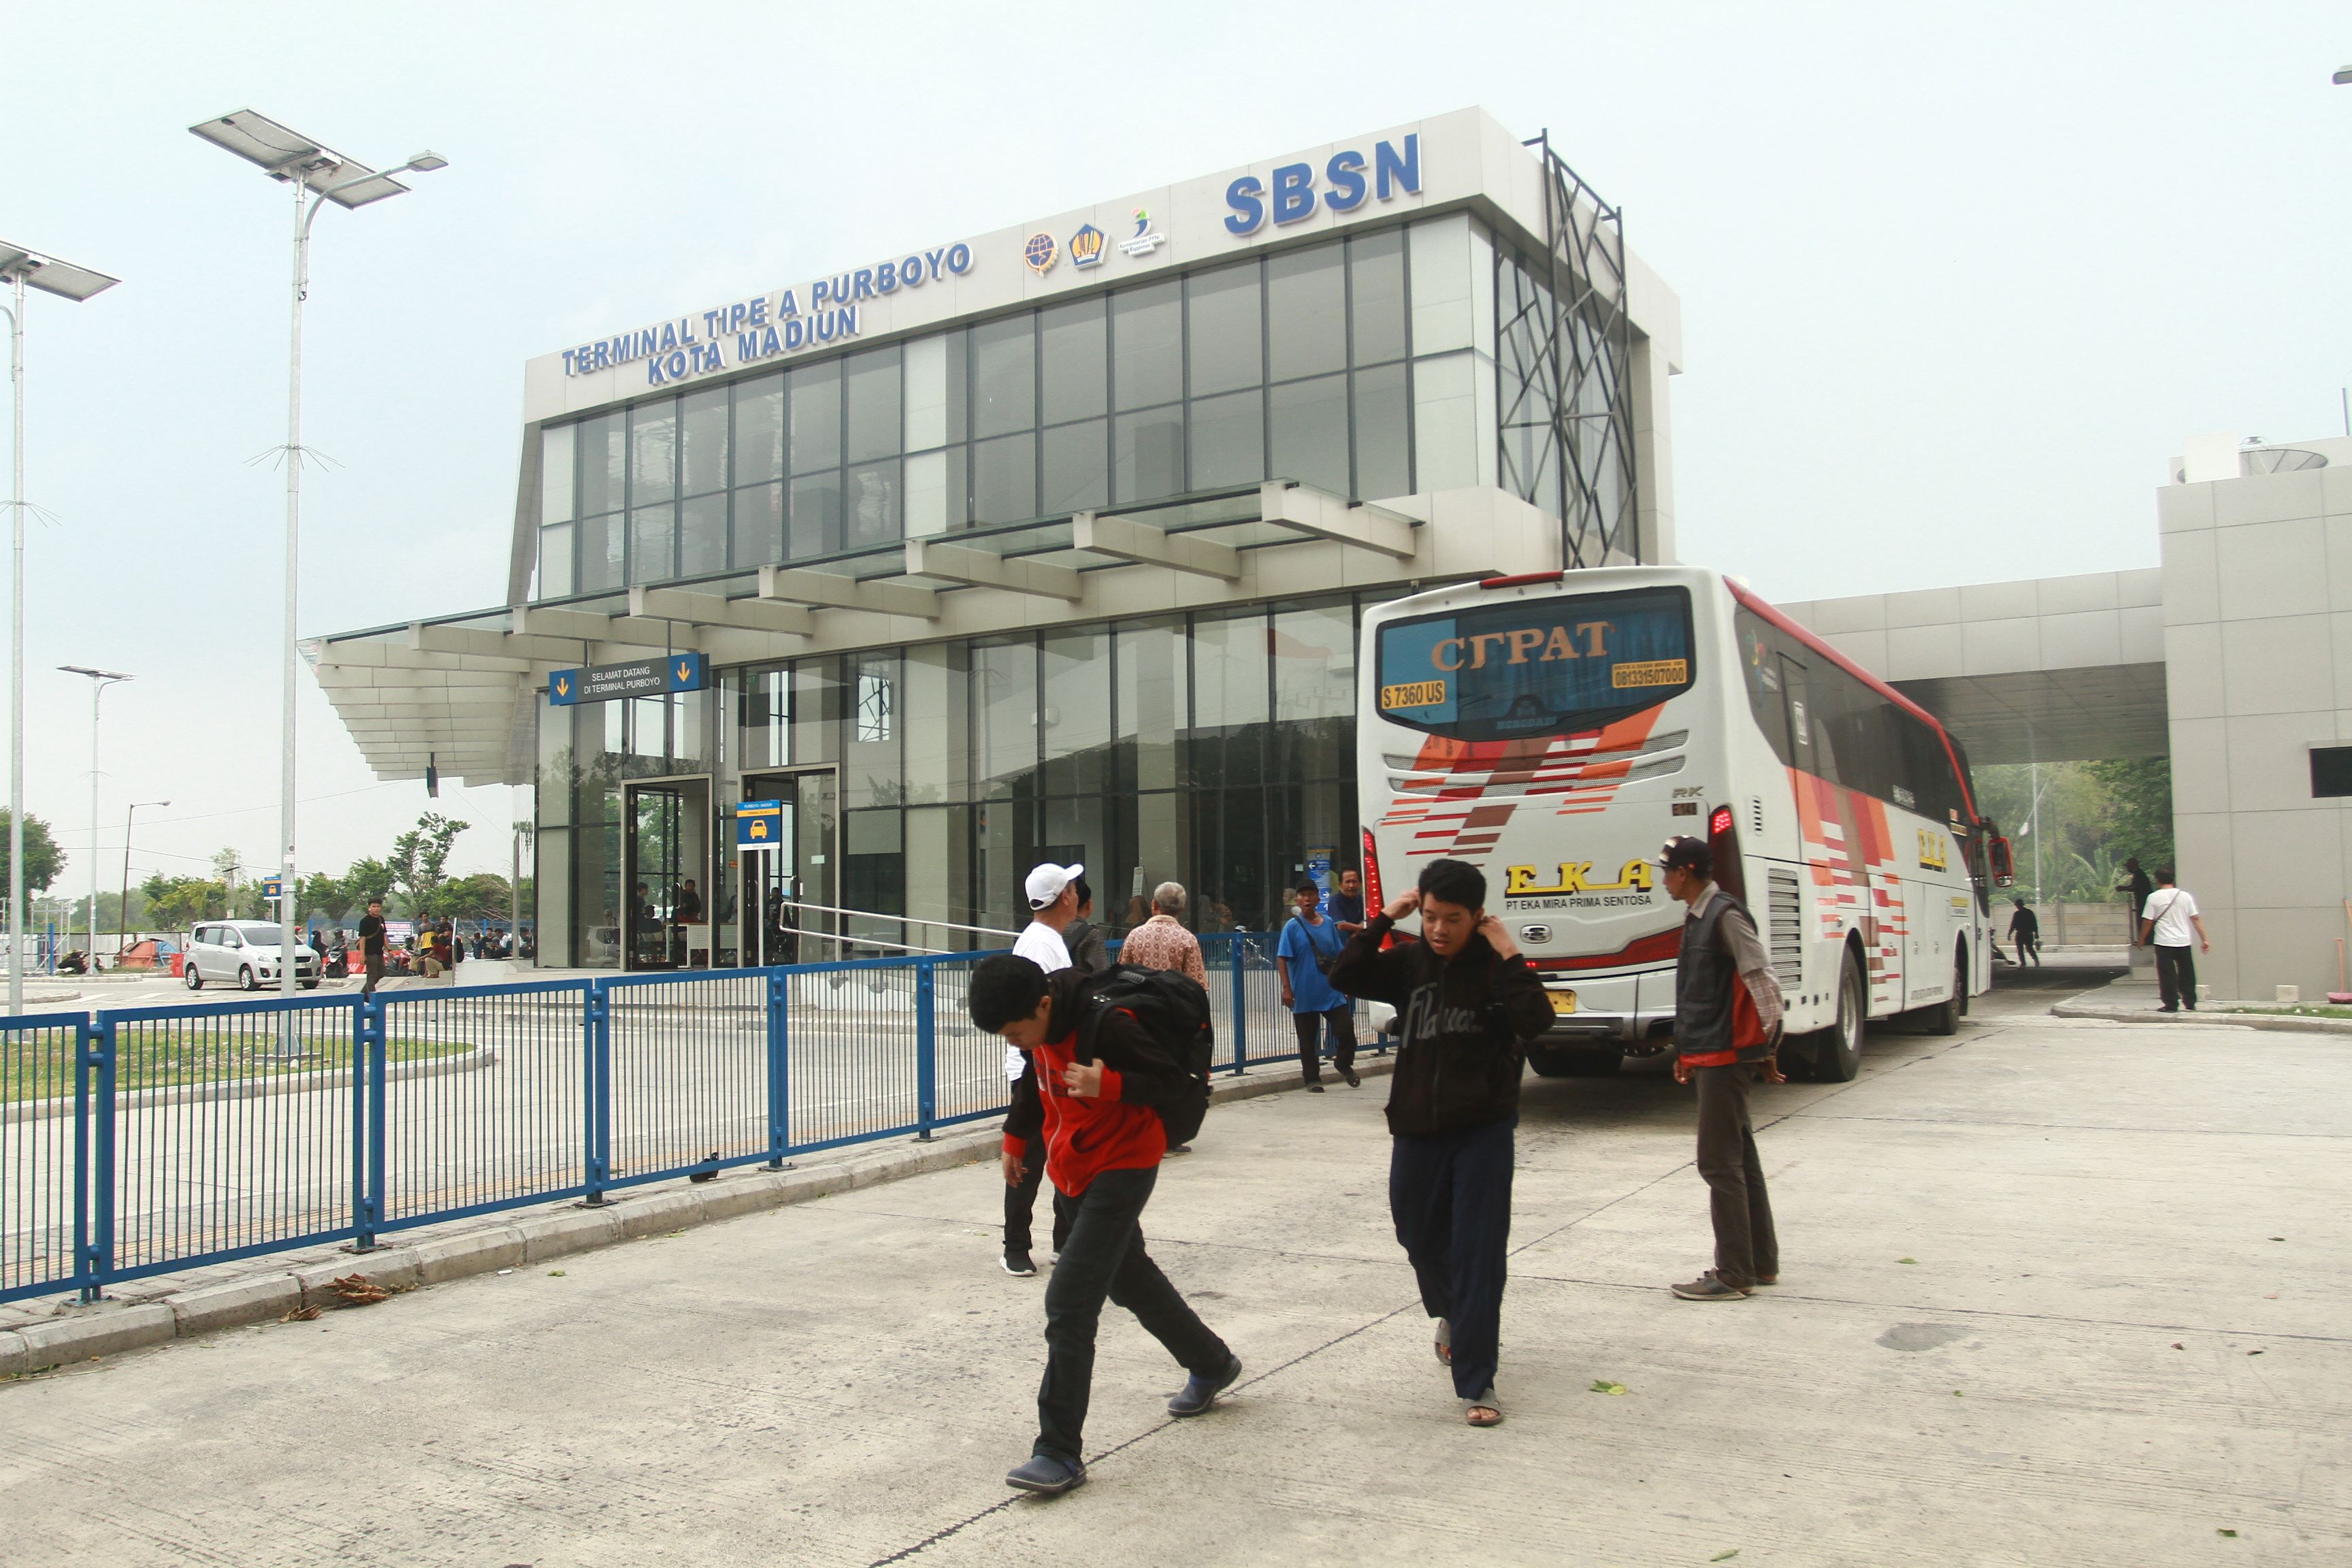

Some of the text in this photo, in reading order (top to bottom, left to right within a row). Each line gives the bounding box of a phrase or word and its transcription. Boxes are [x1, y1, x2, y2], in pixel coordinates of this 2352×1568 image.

[1224, 133, 1422, 236] SBSN
[1130, 244, 1150, 252] Bappenas
[562, 242, 974, 376] TERMINAL TIPE A PURBOYO
[648, 306, 860, 385] KOTA MADIUN
[584, 676, 660, 694] DI TERMINAL PURBOYO
[591, 666, 650, 682] SELAMAT DATANG
[1616, 667, 1684, 686] 081331507000
[1384, 682, 1443, 707] S 7360 US
[1671, 785, 1704, 798] RK
[1918, 829, 1948, 873] EKA
[1505, 858, 1654, 898] EKA
[1506, 895, 1652, 911] PT EKA MIRA PRIMA SENTOSA
